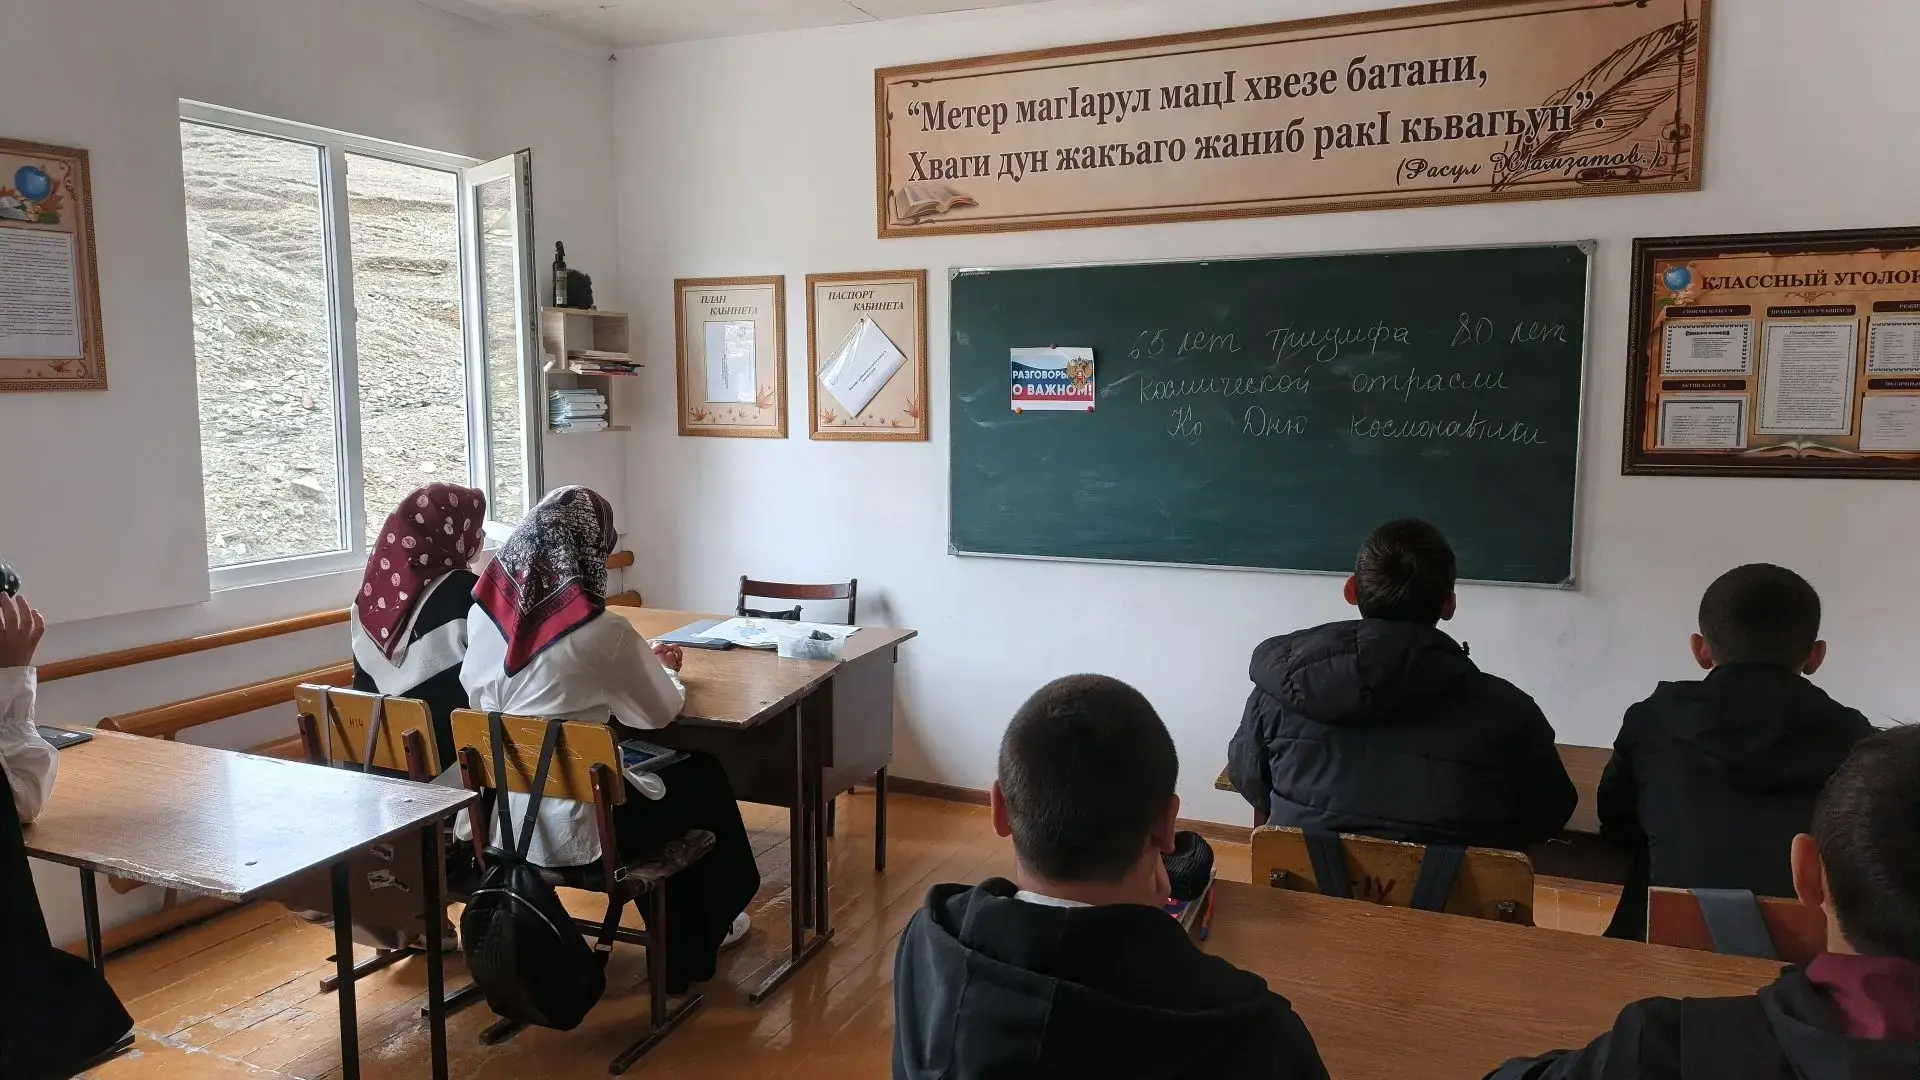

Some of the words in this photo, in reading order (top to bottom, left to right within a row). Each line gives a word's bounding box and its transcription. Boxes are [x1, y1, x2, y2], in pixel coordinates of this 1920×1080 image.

[1244, 65, 1337, 102] хвезе
[1346, 54, 1488, 91] батани,
[907, 151, 991, 182] Хваги
[997, 149, 1049, 182] дун
[1055, 137, 1186, 171] жакъаго
[1194, 117, 1305, 160] жаниб
[1701, 269, 1828, 290] КЛАССНЫЙ
[700, 295, 727, 304] ПЛАН
[828, 290, 875, 300] ПАСПОРТ
[710, 306, 758, 315] КАБИНЕТА
[853, 301, 904, 311] КАБИНЕТА
[1177, 331, 1241, 355] лет
[1451, 312, 1494, 347] 80
[1510, 321, 1568, 344] лет
[1012, 384, 1023, 396] О
[1027, 383, 1092, 396] ВАЖНОМ!
[1352, 367, 1508, 403] отрасли
